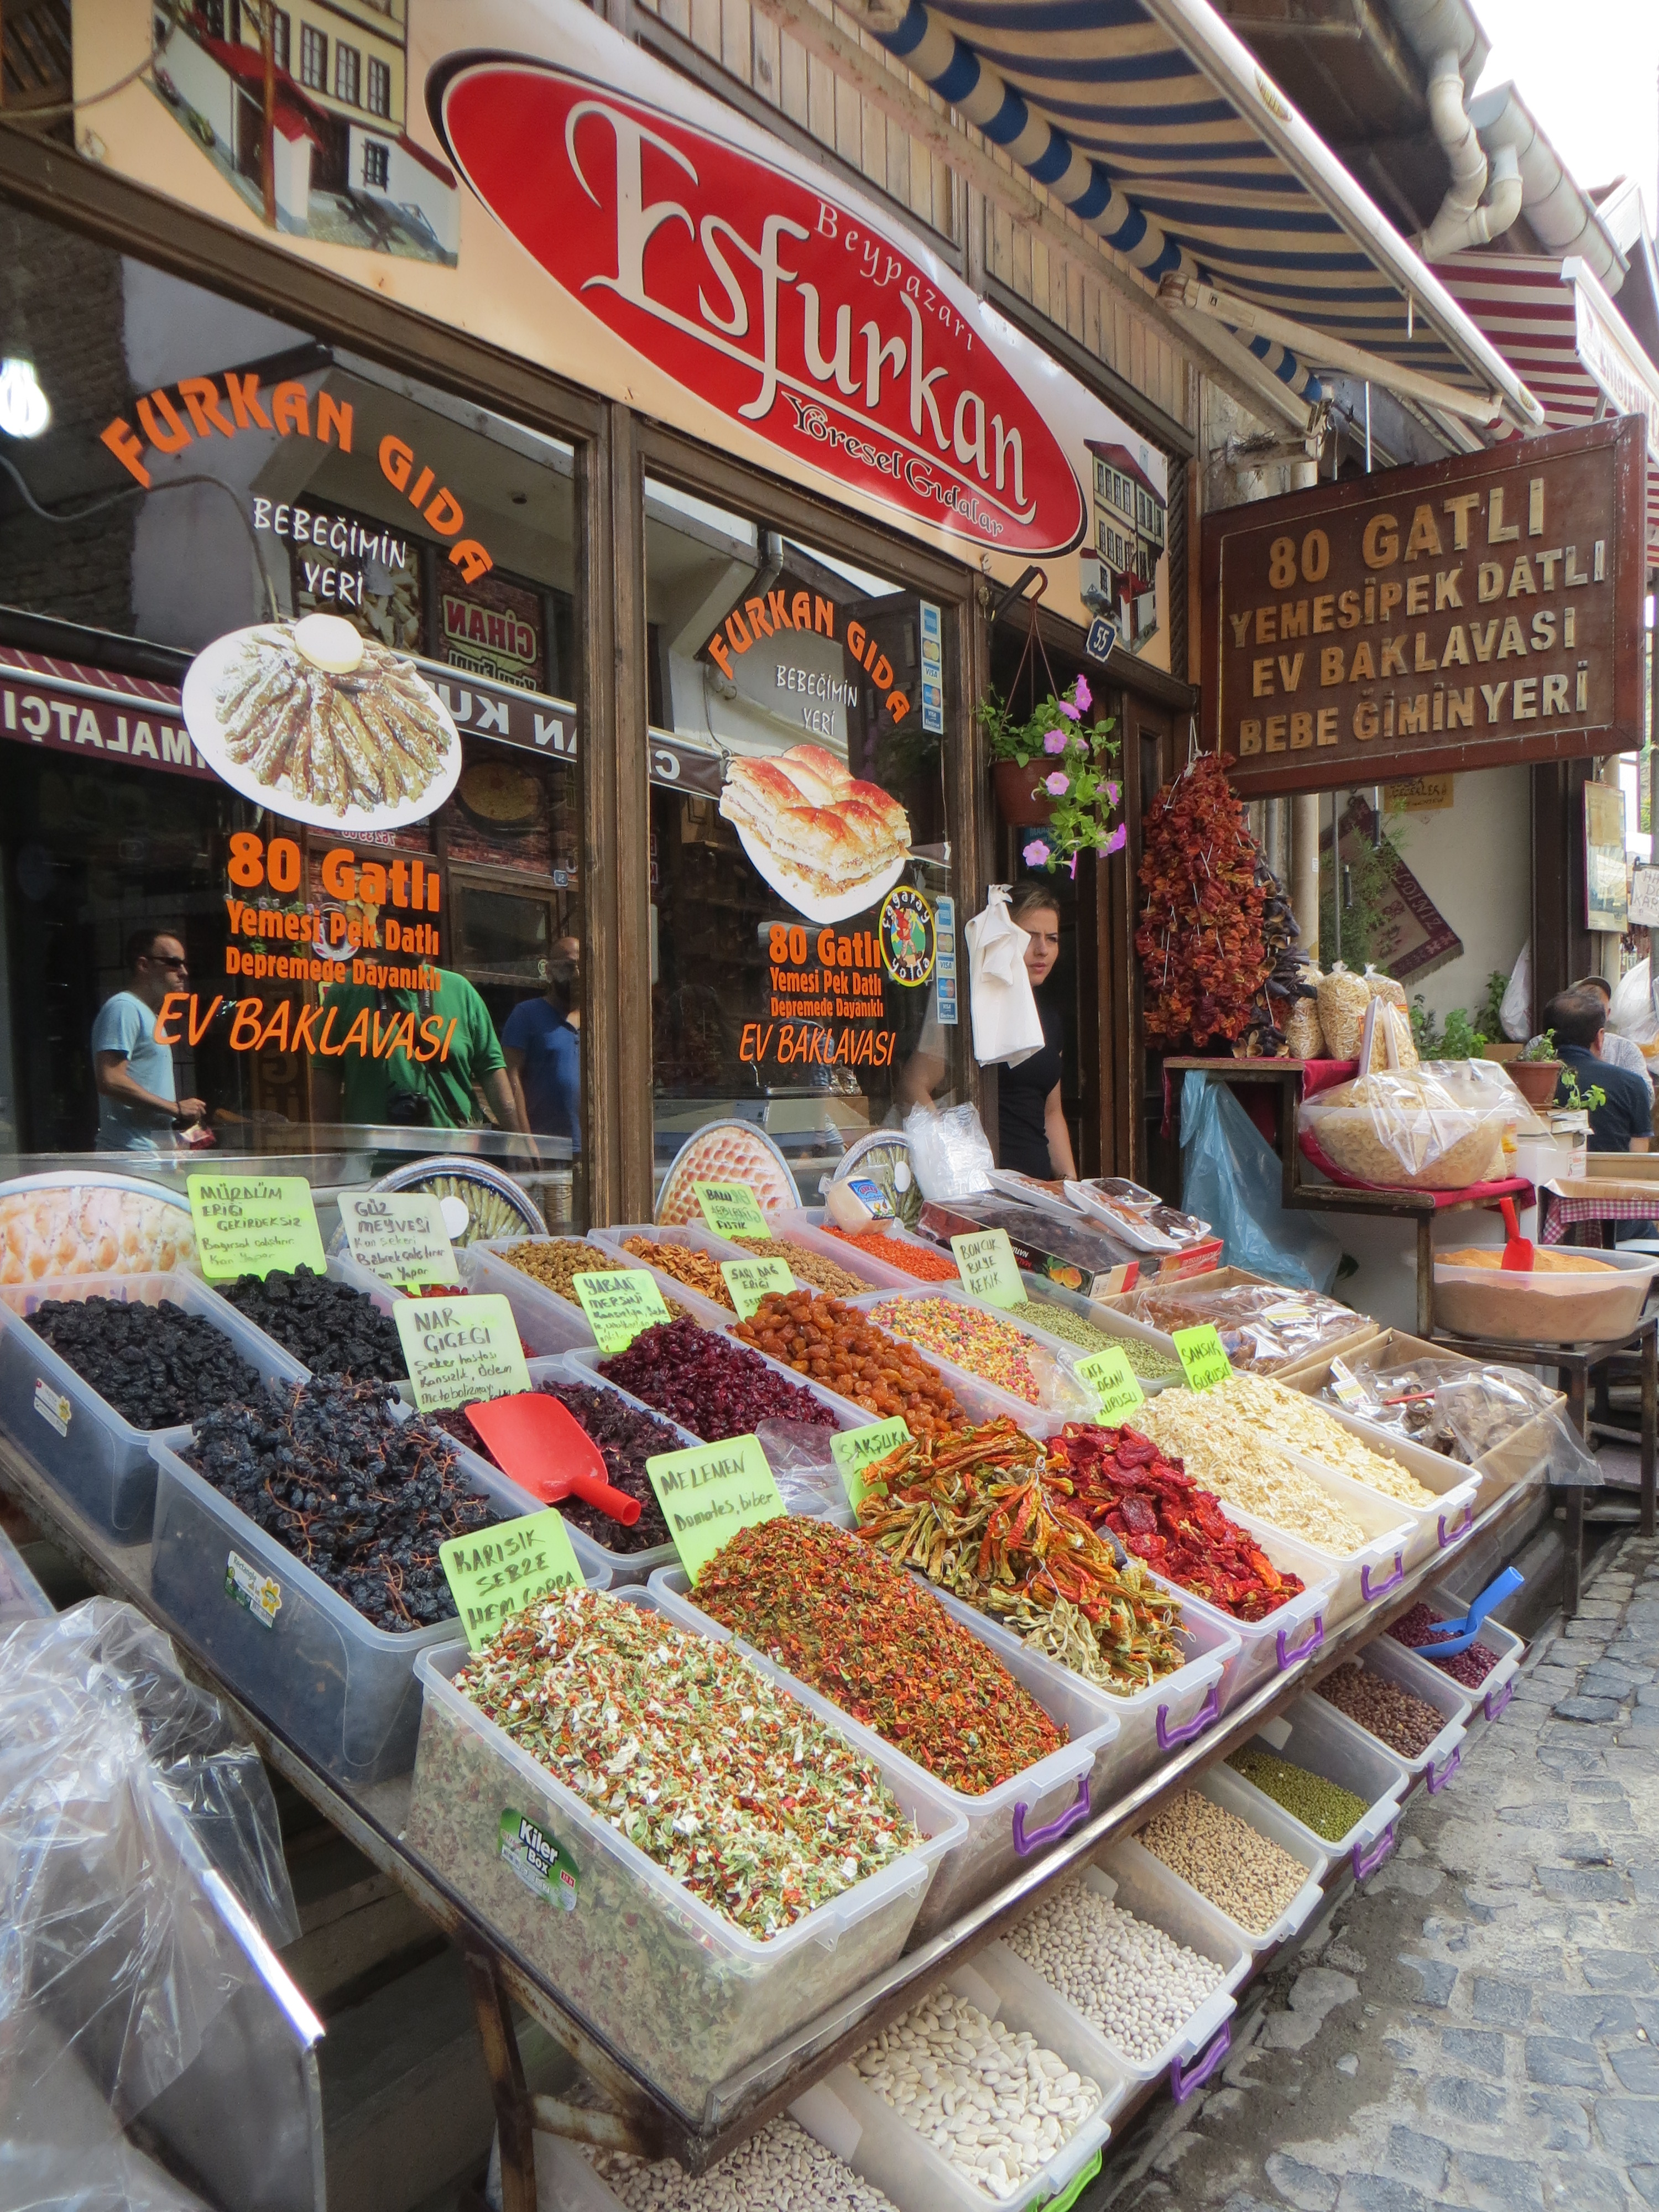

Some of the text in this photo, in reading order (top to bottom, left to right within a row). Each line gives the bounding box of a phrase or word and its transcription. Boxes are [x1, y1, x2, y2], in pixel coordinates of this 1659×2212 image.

[781, 390, 902, 479] Yöresel
[100, 373, 494, 585] FURKAN GIDA
[253, 497, 406, 569] BEBEĞİMİN
[1269, 477, 1545, 591] 80 GATLI
[304, 562, 363, 606] YERİ
[1478, 540, 1605, 604] DATLI
[708, 589, 910, 724] FURKAN GIDA
[1093, 627, 1109, 652] 55
[1252, 607, 1576, 698] EV BAKLAVASI
[776, 665, 858, 708] BEBEĞİMİN
[925, 667, 938, 679] VISA
[803, 707, 835, 736] YERİ
[1240, 707, 1339, 757] BEBE
[227, 832, 440, 912] 80 Gatlı
[226, 899, 439, 956] Yemesi Pek Datlı
[769, 924, 881, 968] 80 Gatlı
[226, 946, 441, 992] Depremede Dayanıklı
[770, 967, 882, 996] Yemesi Pek Datlı
[940, 961, 952, 970] VISA
[153, 992, 457, 1063] EV BAKLAVASI
[771, 997, 884, 1019] Depremede Dayanıklı
[739, 1024, 896, 1066] EV BAKLAVASI
[960, 1239, 1002, 1260] BONCUK
[414, 1307, 461, 1332] NAR
[660, 1451, 746, 1496] MELEMEN
[467, 1597, 515, 1631] HEM
[519, 1819, 559, 1863] Kiler
[527, 1849, 549, 1875] Box
